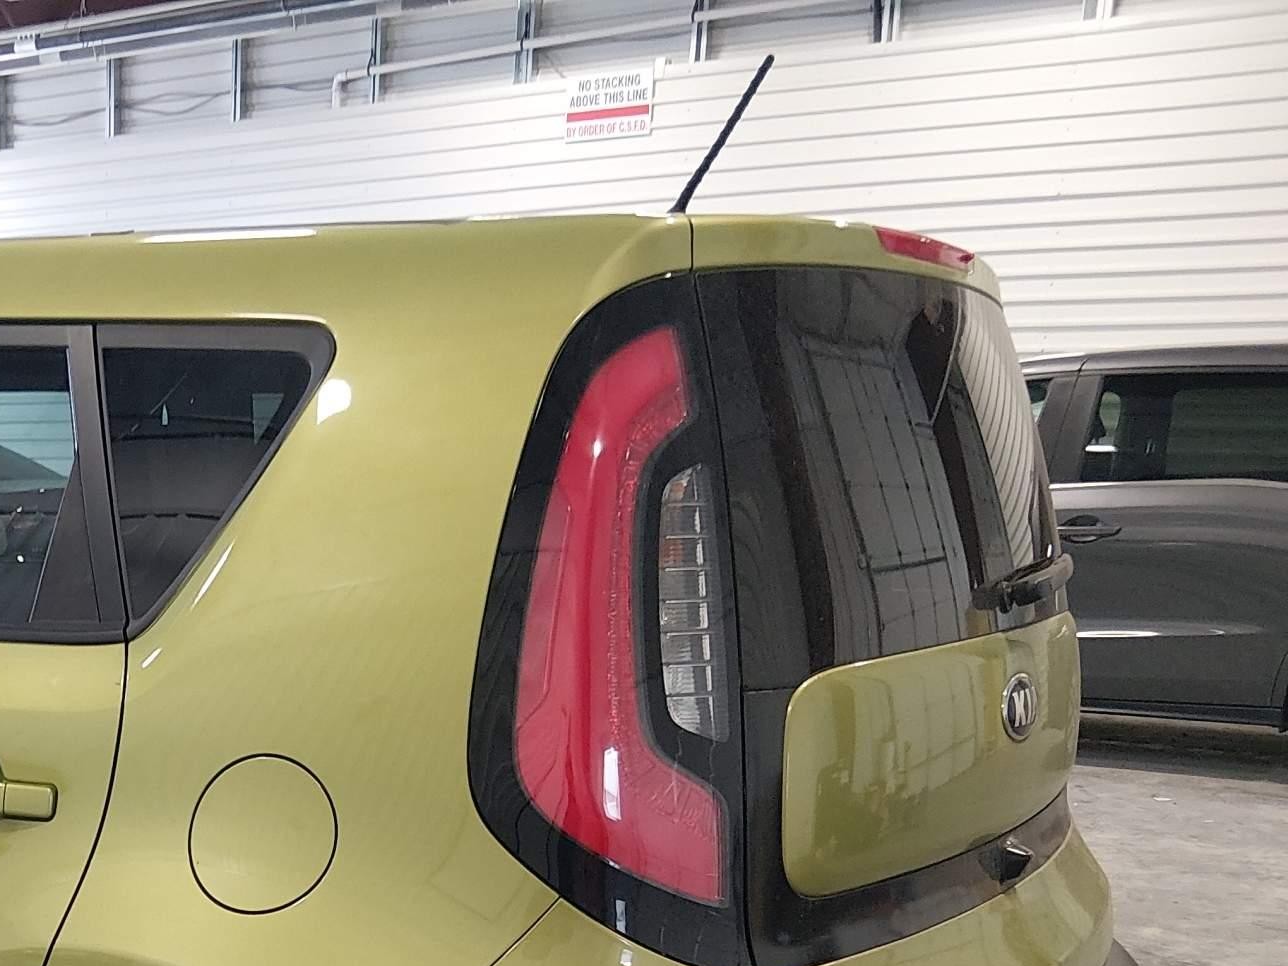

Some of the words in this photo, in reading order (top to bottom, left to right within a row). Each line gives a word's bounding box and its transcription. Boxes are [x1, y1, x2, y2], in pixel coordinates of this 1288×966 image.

[578, 79, 592, 93] NO
[594, 74, 641, 90] STACKING
[569, 93, 601, 108] ABOVE
[603, 90, 624, 105] THIS
[627, 87, 649, 103] LINE
[578, 124, 605, 137] ORDER
[606, 121, 617, 135] OF
